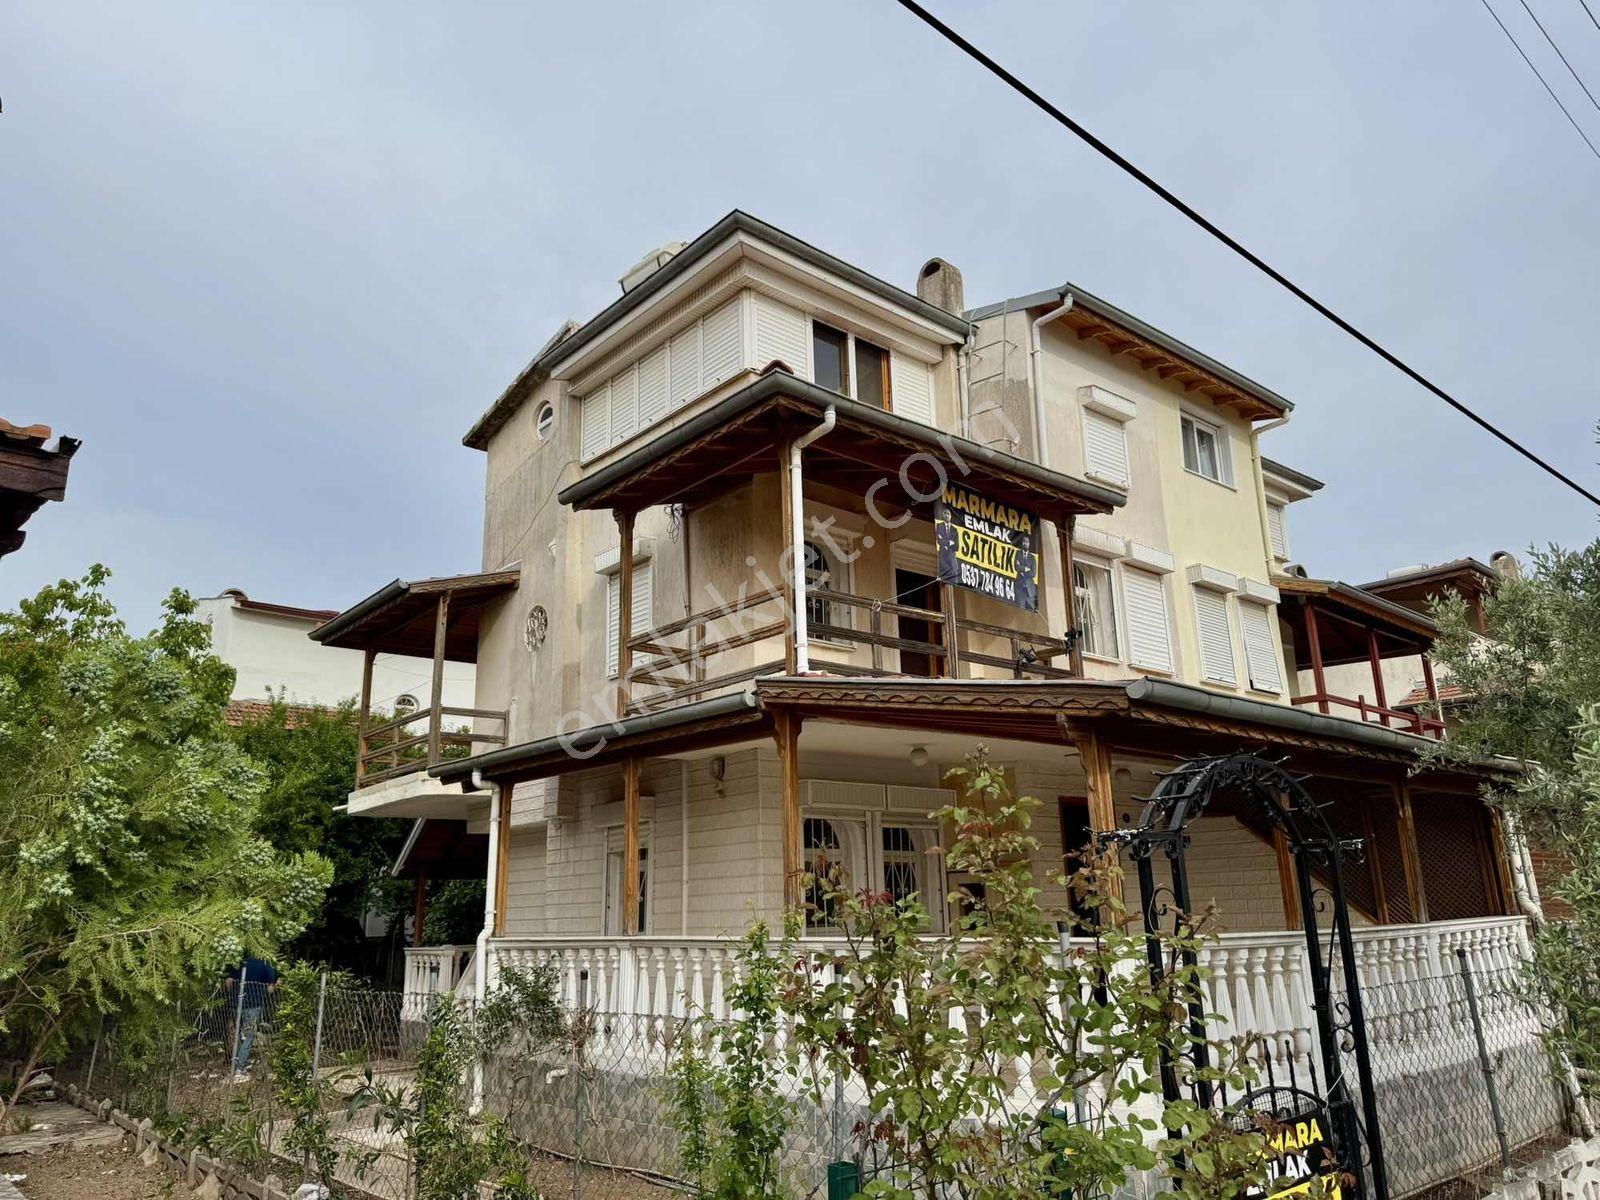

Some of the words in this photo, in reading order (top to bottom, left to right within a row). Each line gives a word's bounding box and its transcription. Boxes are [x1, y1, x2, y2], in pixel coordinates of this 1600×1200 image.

[941, 486, 1032, 535] MARMARA
[964, 514, 1012, 544] EMLAK
[961, 530, 1016, 574] SATILIK
